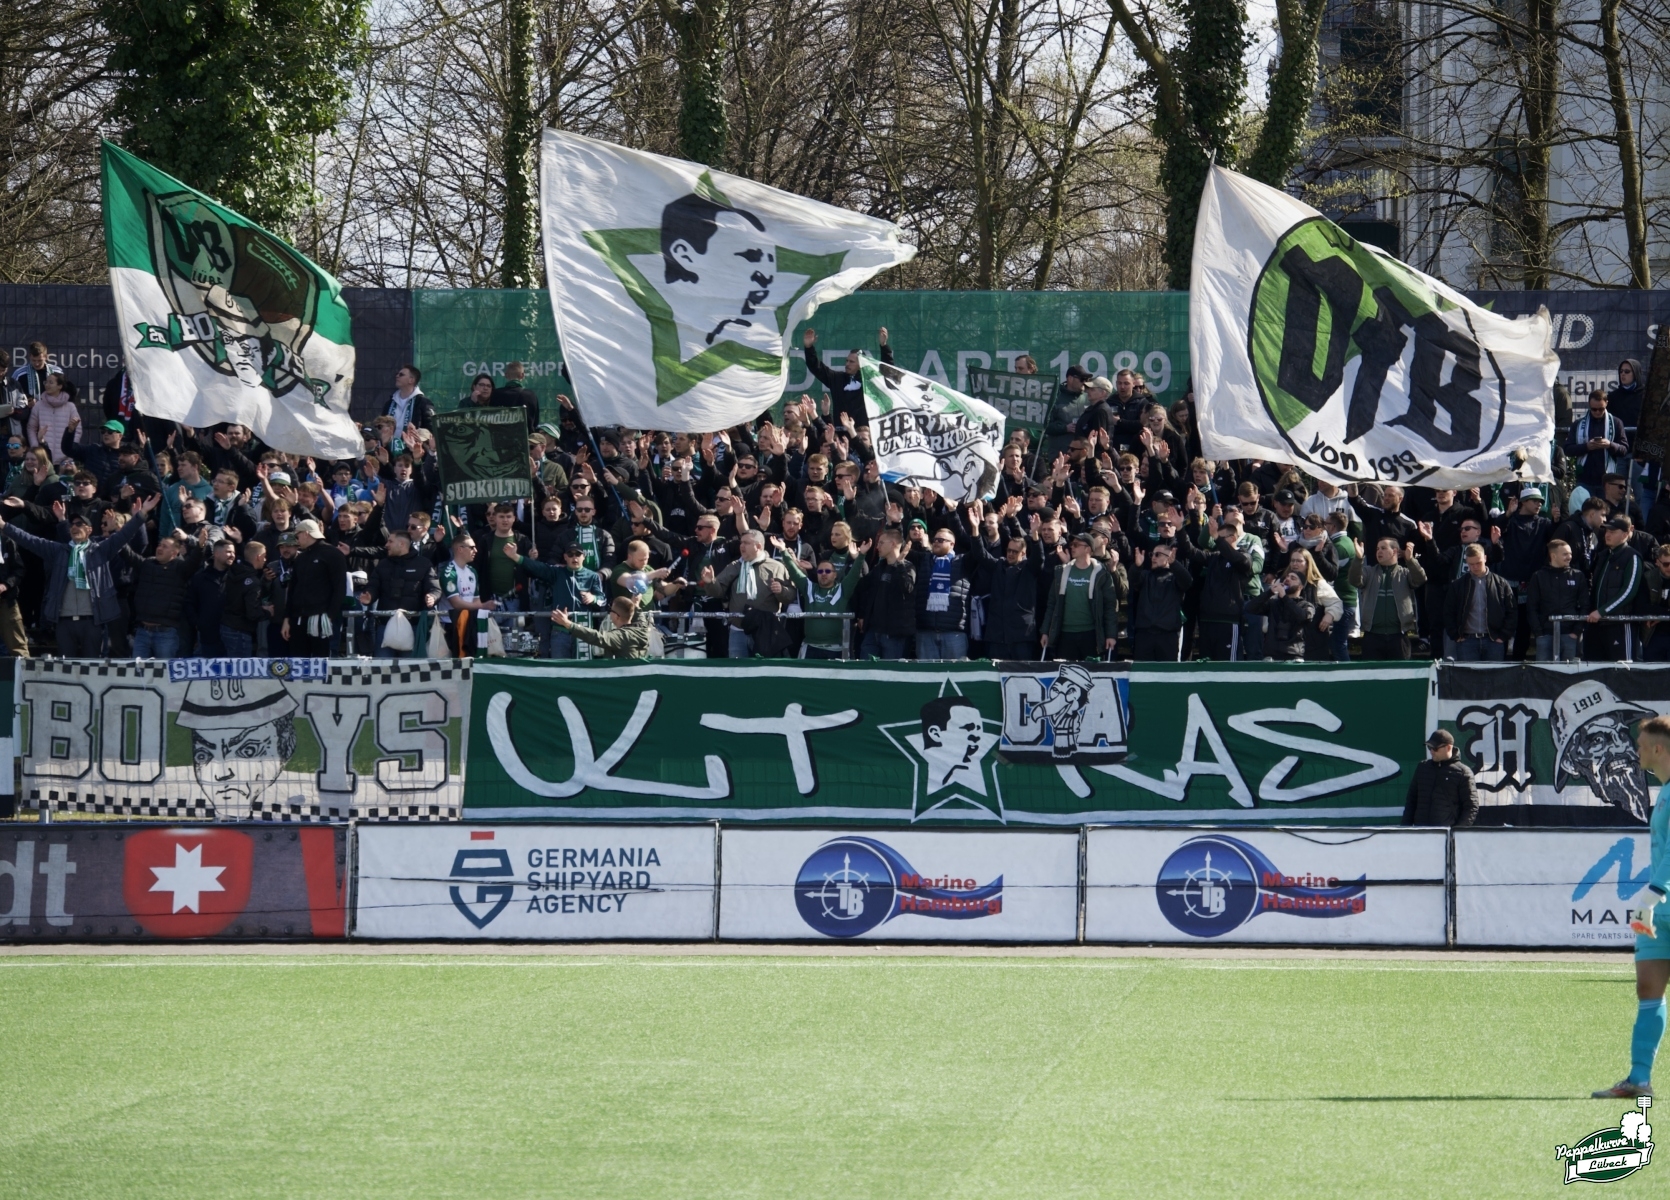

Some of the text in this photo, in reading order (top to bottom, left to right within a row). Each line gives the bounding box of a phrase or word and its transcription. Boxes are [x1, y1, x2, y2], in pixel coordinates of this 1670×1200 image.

[12, 347, 126, 368] Bsuche
[1050, 350, 1172, 394] 1989
[1308, 432, 1359, 471] von
[171, 658, 268, 680] SEKTION
[526, 847, 661, 868] GERMANIA
[526, 870, 651, 891] SHIPYARD
[900, 873, 977, 891] Marine
[1262, 871, 1340, 889] Marine
[525, 893, 628, 914] AGENCY
[900, 894, 1002, 916] Hamburg
[1262, 892, 1366, 914] Hamburg
